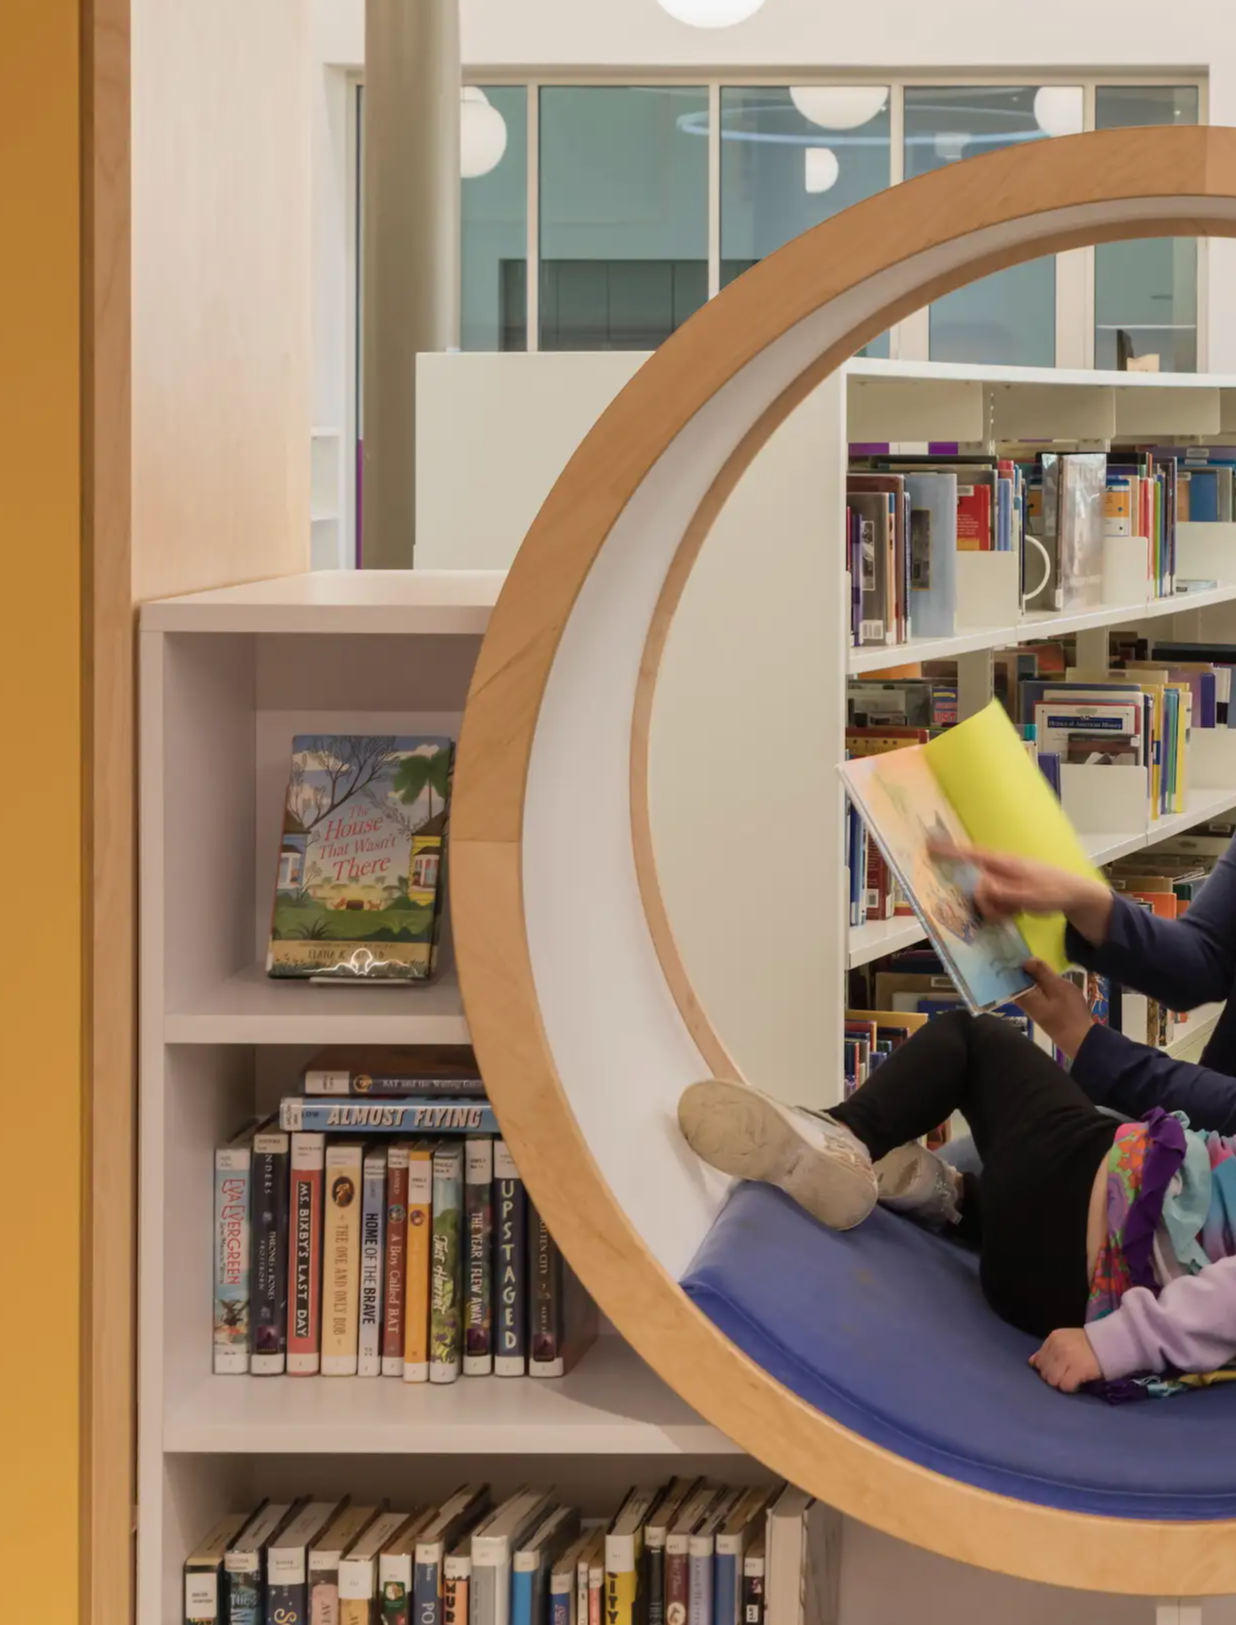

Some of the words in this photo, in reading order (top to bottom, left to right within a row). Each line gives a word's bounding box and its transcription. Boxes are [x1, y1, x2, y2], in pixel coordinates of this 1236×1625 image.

[350, 803, 369, 819] The
[325, 814, 384, 842] House
[319, 843, 355, 861] That
[353, 834, 397, 856] Wasn't
[333, 856, 391, 883] There
[327, 1105, 407, 1127] ALMOST
[414, 1107, 482, 1128] FLYING
[298, 1183, 309, 1205] MS.
[298, 1208, 310, 1257] BIXBY'S
[336, 1224, 348, 1244] THE
[365, 1212, 379, 1245] HOME
[471, 1212, 483, 1230] THE
[222, 1205, 246, 1285] EVERGREEN
[335, 1246, 347, 1265] ONE
[364, 1247, 377, 1261] OF
[389, 1246, 401, 1266] Boy
[433, 1235, 448, 1262] Just
[471, 1232, 482, 1258] YEAR
[334, 1268, 347, 1288] AND
[364, 1264, 377, 1285] THE
[501, 1181, 517, 1349] UPSTAGED
[297, 1264, 308, 1300] LAST
[388, 1270, 400, 1304] Called
[433, 1265, 447, 1314] Harriet
[471, 1268, 482, 1292] FLEW
[333, 1290, 347, 1314] ONLY
[363, 1287, 377, 1324] BRAVE
[470, 1297, 482, 1324] AWAY
[296, 1309, 308, 1336] DAY
[387, 1308, 399, 1334] BAT
